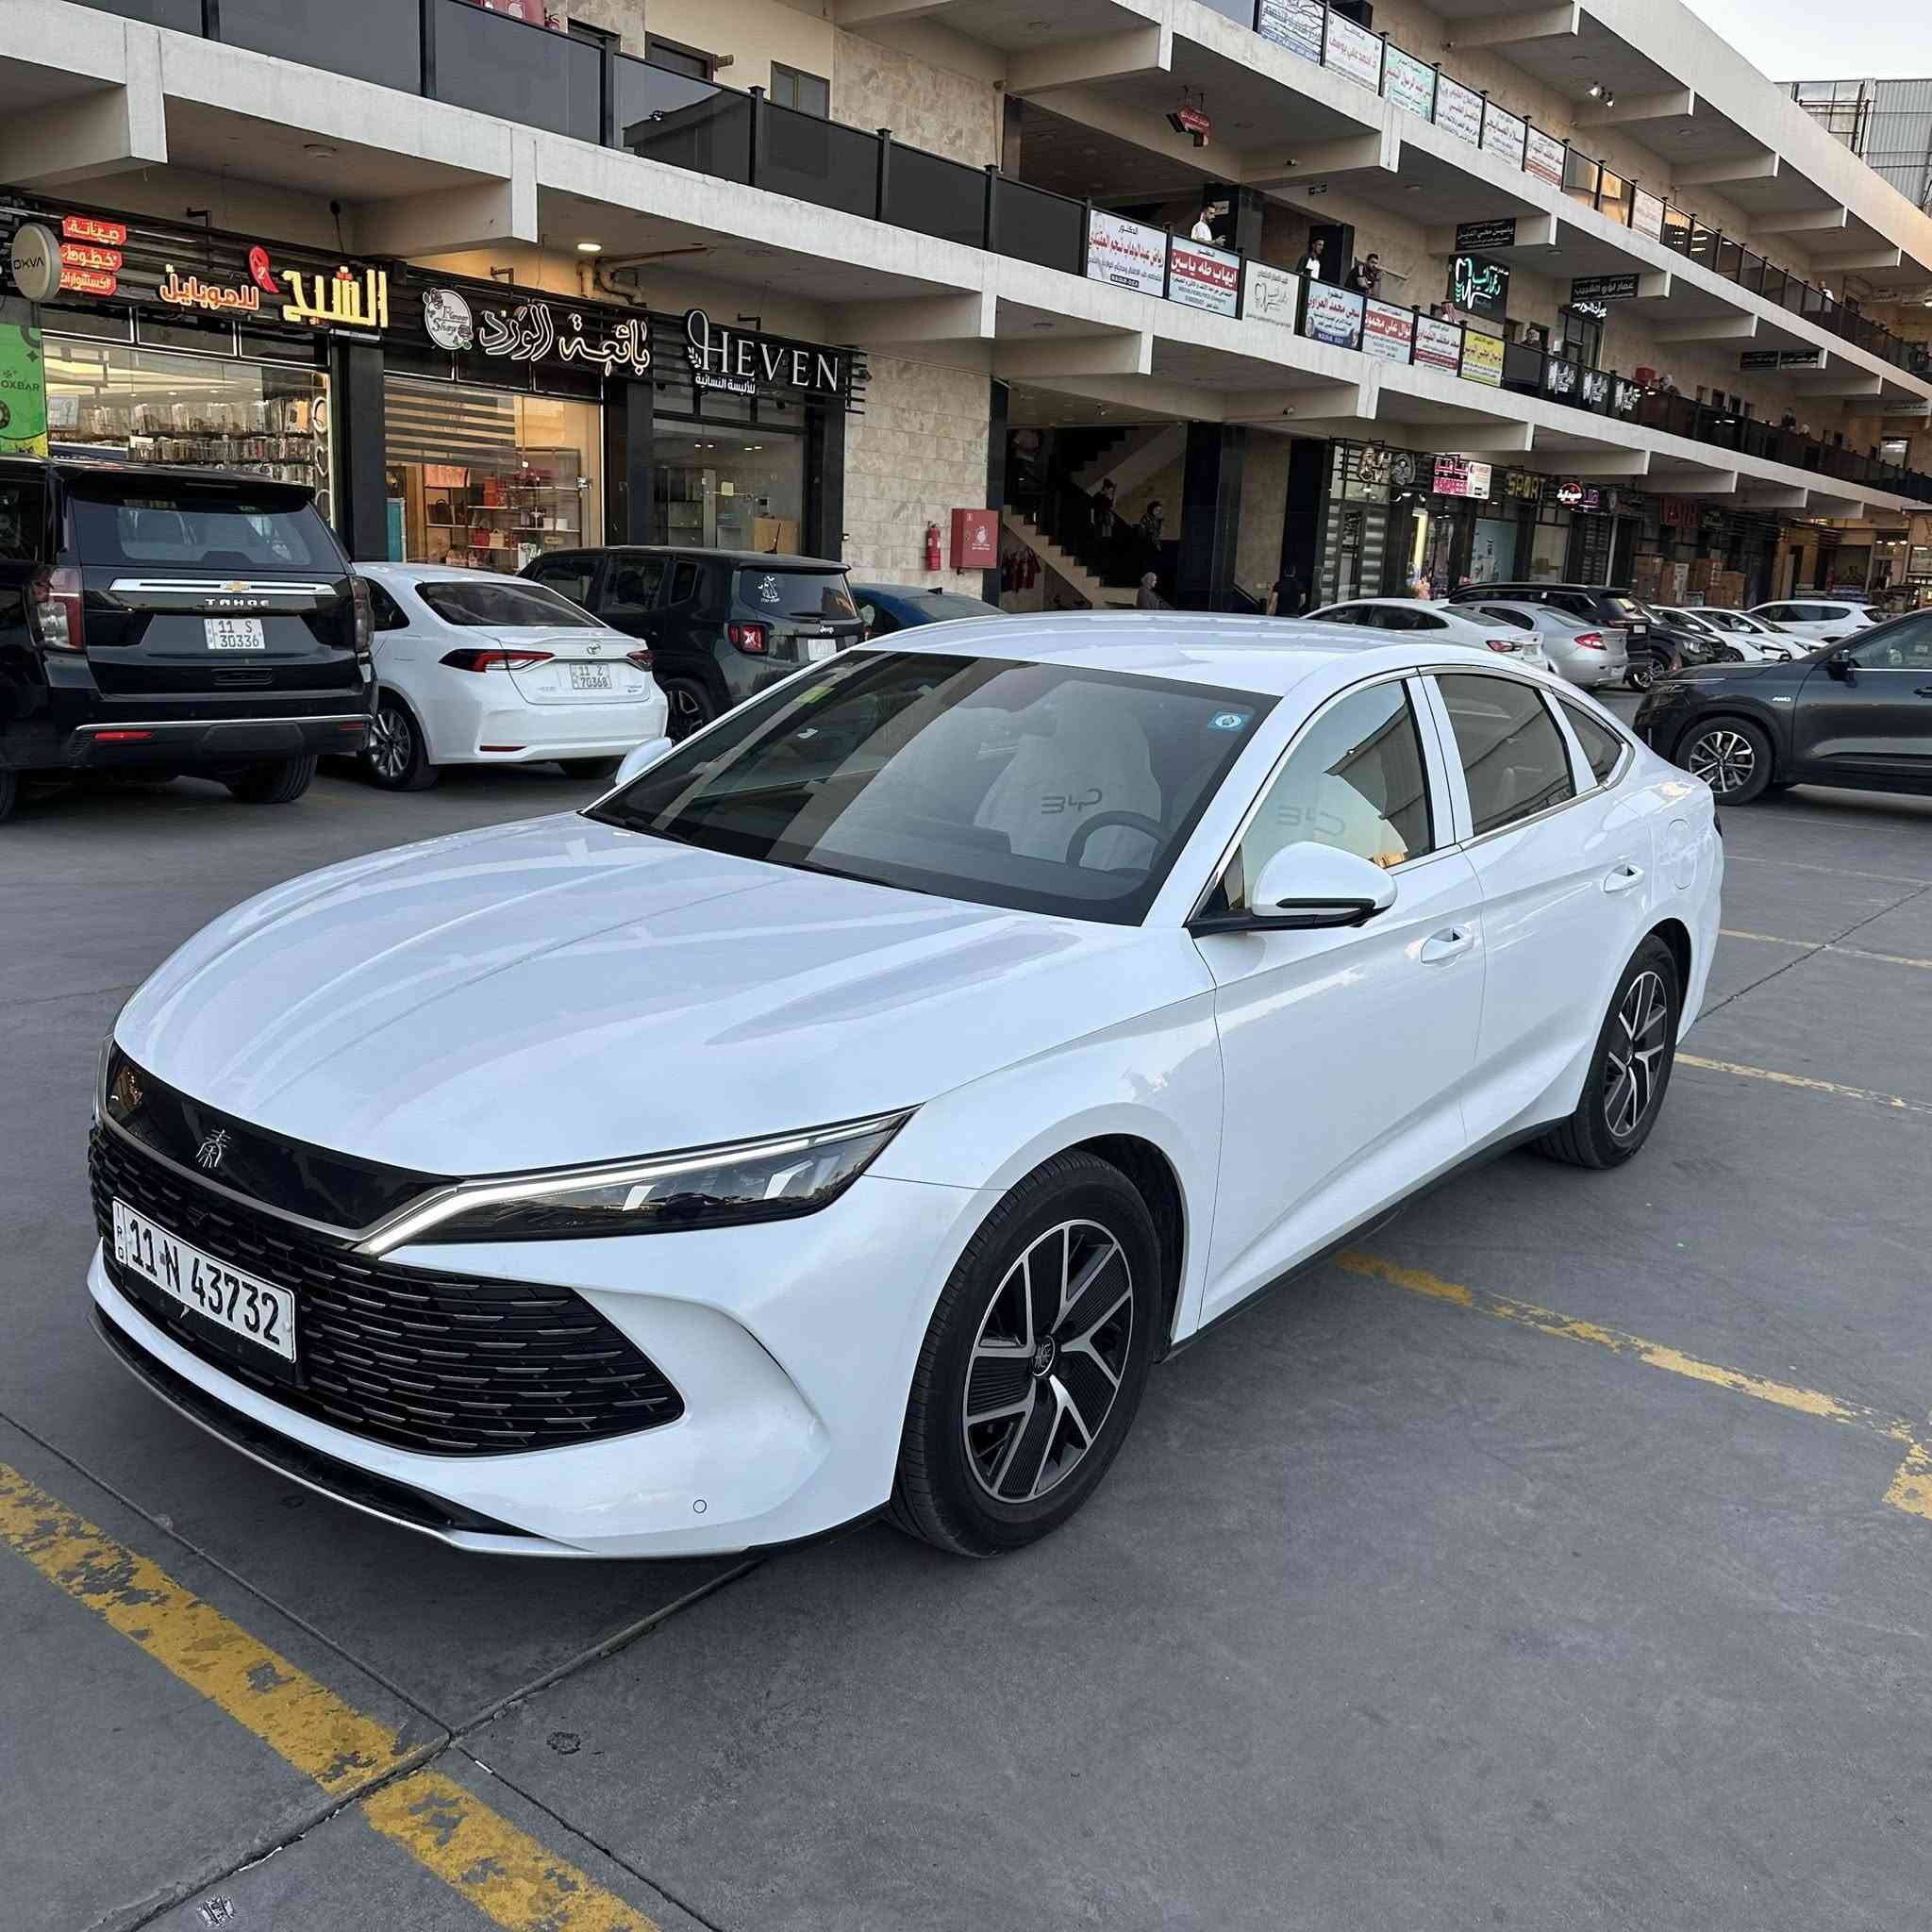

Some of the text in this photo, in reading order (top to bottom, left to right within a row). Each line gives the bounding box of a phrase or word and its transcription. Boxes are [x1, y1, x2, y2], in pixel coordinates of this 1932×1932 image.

[67, 219, 120, 244] صيانة
[1171, 252, 1196, 275] ياسين
[1198, 260, 1212, 275] طه
[159, 273, 259, 310] للموبايل
[479, 303, 650, 376] بائعة الورد
[688, 309, 839, 391] HEVEN
[219, 621, 252, 633] 11 S
[820, 625, 834, 634] Jeep
[220, 635, 259, 647] 30336
[579, 665, 590, 675] 11
[130, 1220, 280, 1345] 11 N 43732
